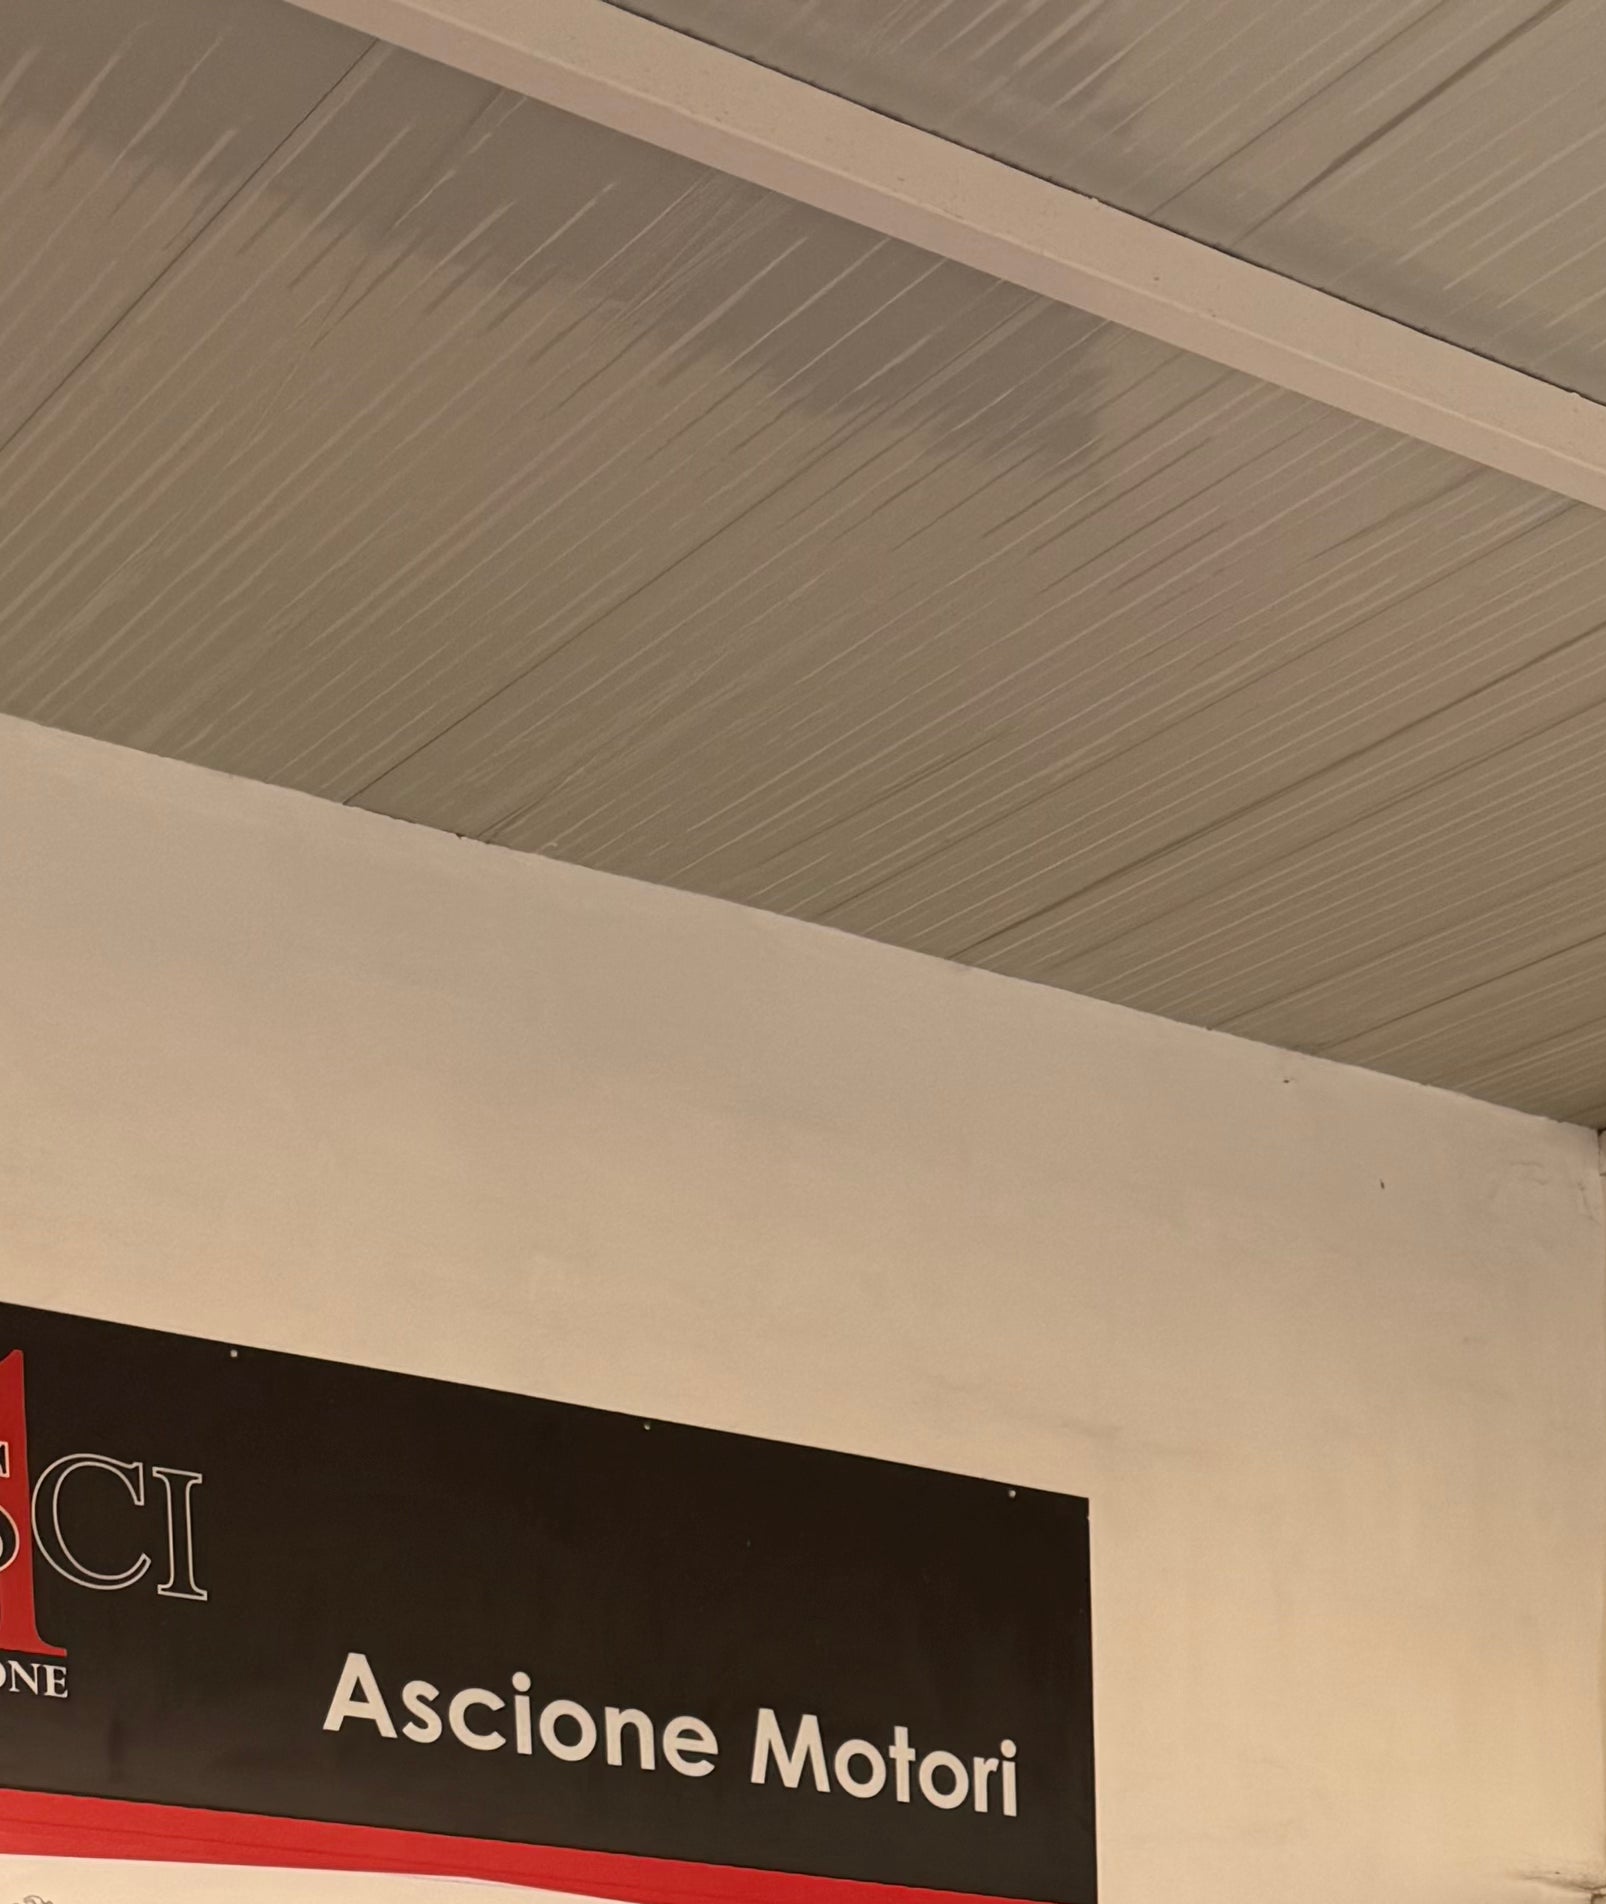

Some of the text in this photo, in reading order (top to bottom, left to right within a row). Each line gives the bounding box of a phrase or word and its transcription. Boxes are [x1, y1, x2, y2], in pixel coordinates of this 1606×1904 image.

[0, 1660, 68, 1698] NE
[322, 1652, 1018, 1818] Ascione Motori
